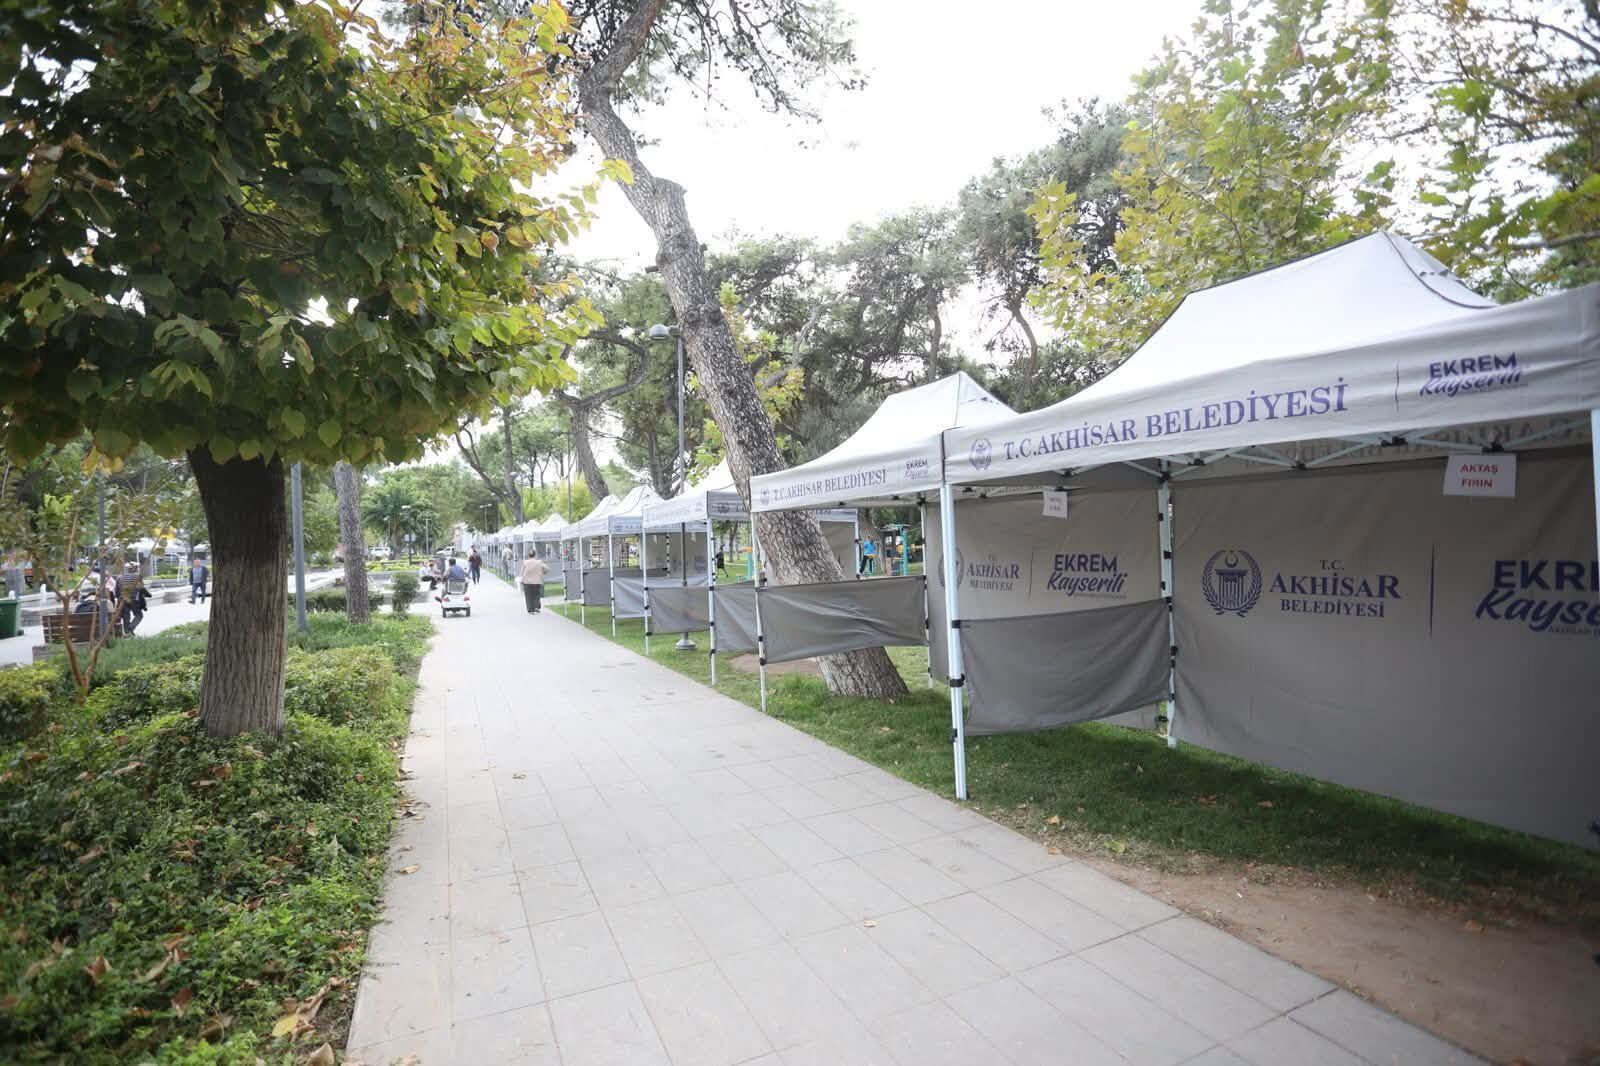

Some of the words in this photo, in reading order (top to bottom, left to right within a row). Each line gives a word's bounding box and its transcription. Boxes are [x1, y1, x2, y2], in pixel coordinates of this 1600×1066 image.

[1429, 352, 1518, 379] EKREM
[1145, 376, 1349, 438] BELEDİYESİ
[1053, 553, 1119, 574] EKREM
[1319, 559, 1345, 571] T.C.
[1046, 572, 1129, 597] Kayserili
[1269, 572, 1403, 599] AKHİSAR
[1280, 599, 1385, 618] BELEDİYESİ
